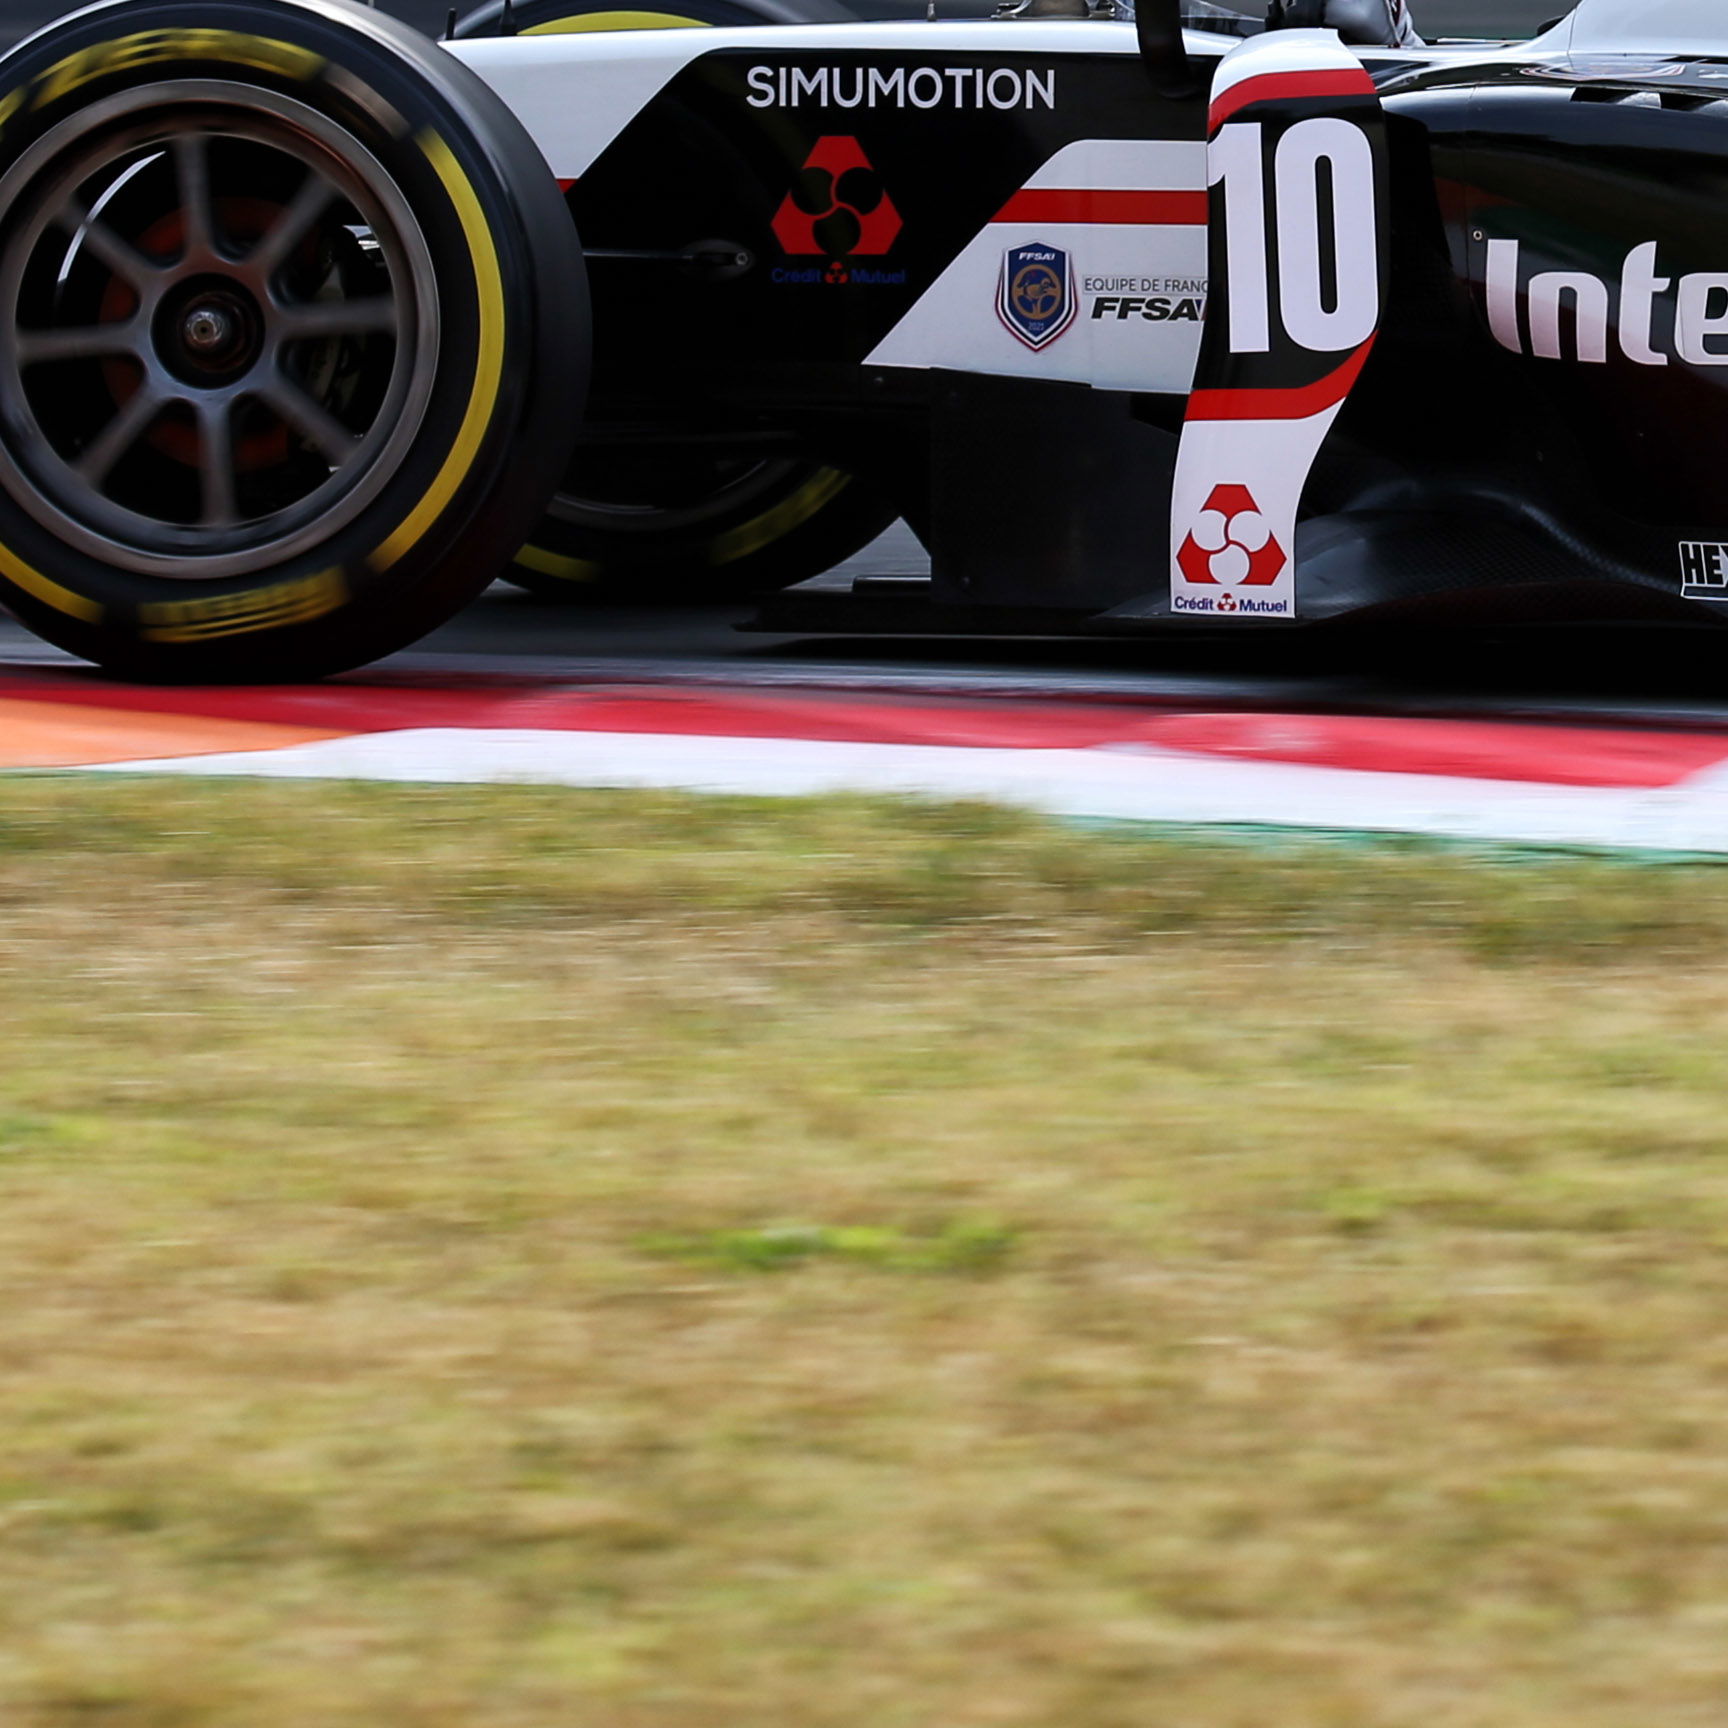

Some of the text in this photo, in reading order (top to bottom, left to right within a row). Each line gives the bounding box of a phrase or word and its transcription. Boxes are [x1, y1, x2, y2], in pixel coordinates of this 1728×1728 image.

[745, 65, 1056, 110] SIMUMOTION
[1207, 116, 1380, 354] 10
[850, 268, 907, 284] Mutuel
[1084, 277, 1208, 293] EQUIPE DE FRANC
[1174, 595, 1288, 613] Crédit Mutuel
